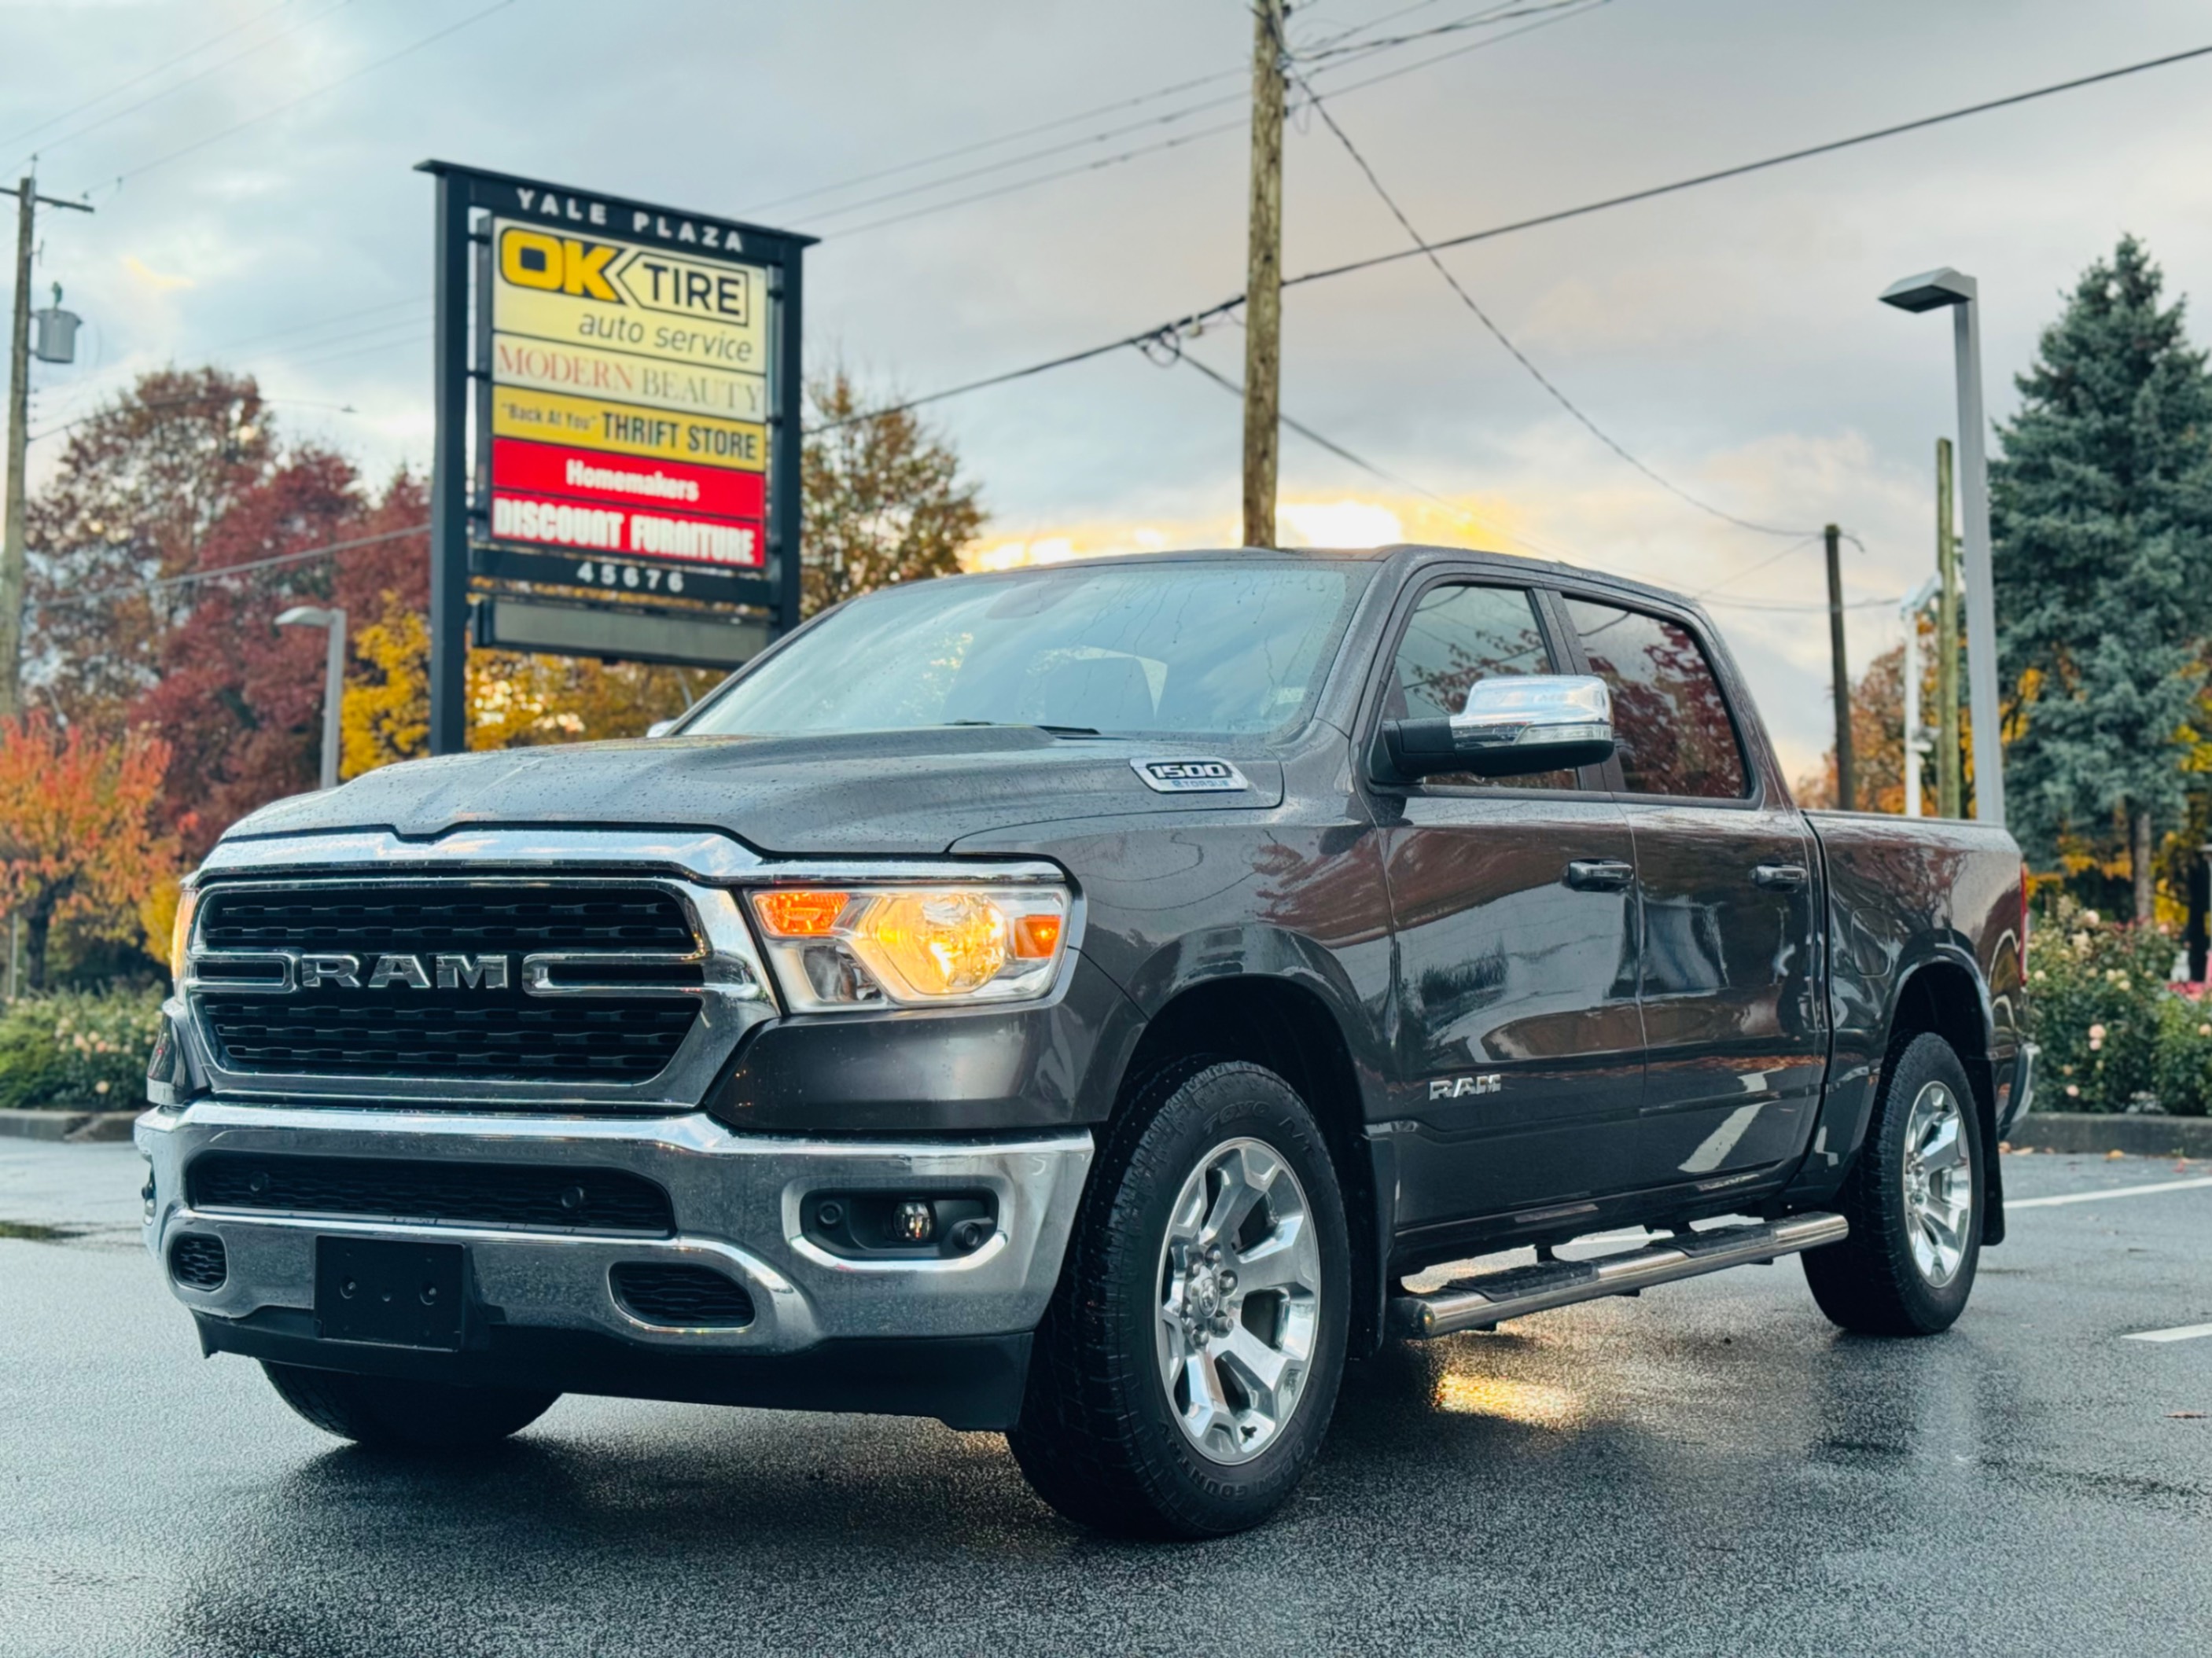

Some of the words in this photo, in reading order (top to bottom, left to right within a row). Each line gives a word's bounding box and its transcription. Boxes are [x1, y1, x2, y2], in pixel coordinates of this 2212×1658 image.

[517, 187, 608, 225] YALE
[634, 211, 743, 252] PLAZA
[501, 227, 621, 304] OK
[642, 262, 742, 316] TIRE
[579, 312, 645, 344] auto
[654, 325, 753, 362] service
[498, 344, 633, 391] MODERN
[642, 368, 764, 414] BEAUTY
[602, 413, 679, 448] THRIFT
[687, 425, 757, 460] STORE
[565, 458, 700, 502] Homemakers
[493, 497, 626, 548] DISCOUNT
[630, 513, 756, 564] FURNITURE
[577, 561, 684, 593] 45676
[1150, 764, 1227, 778] 1500
[301, 953, 508, 990] RAM
[1430, 1074, 1502, 1101] RAM
[1202, 1100, 1272, 1136] TOYO
